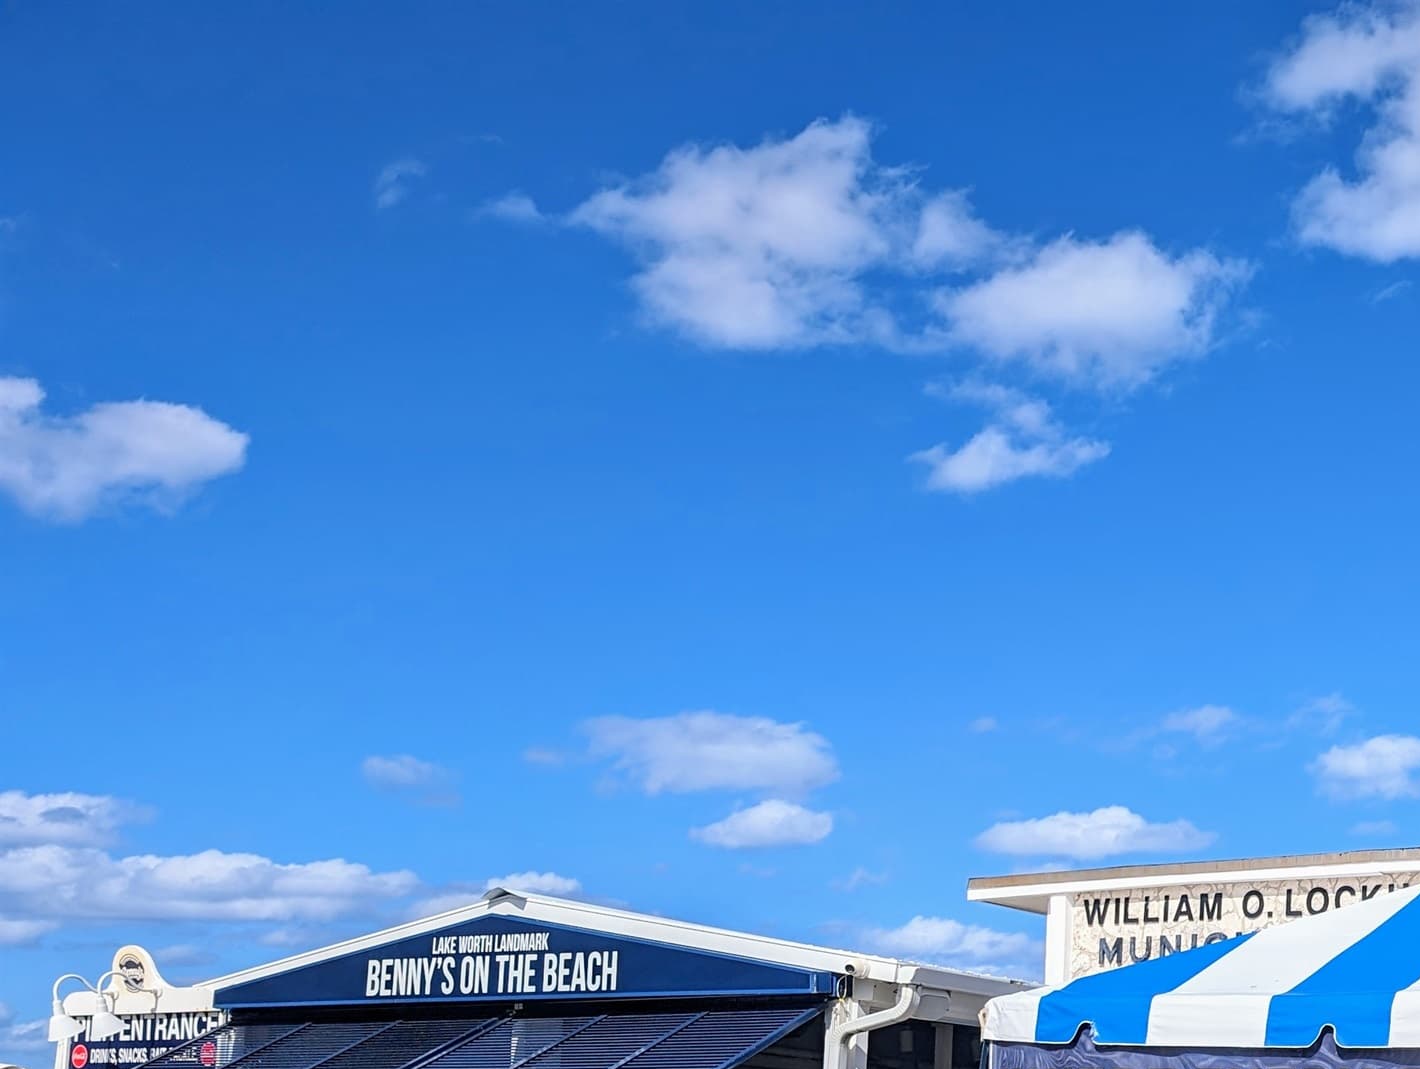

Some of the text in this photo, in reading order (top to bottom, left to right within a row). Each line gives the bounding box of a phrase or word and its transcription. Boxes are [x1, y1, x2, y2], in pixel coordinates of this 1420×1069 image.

[1083, 891, 1223, 926] WILLIAM
[1241, 889, 1274, 920] O.
[432, 932, 550, 955] LAKE WORTH LANDMARK
[365, 950, 619, 997] BENNY'S ON THE BEACH
[119, 1013, 218, 1042] ENTRANCE
